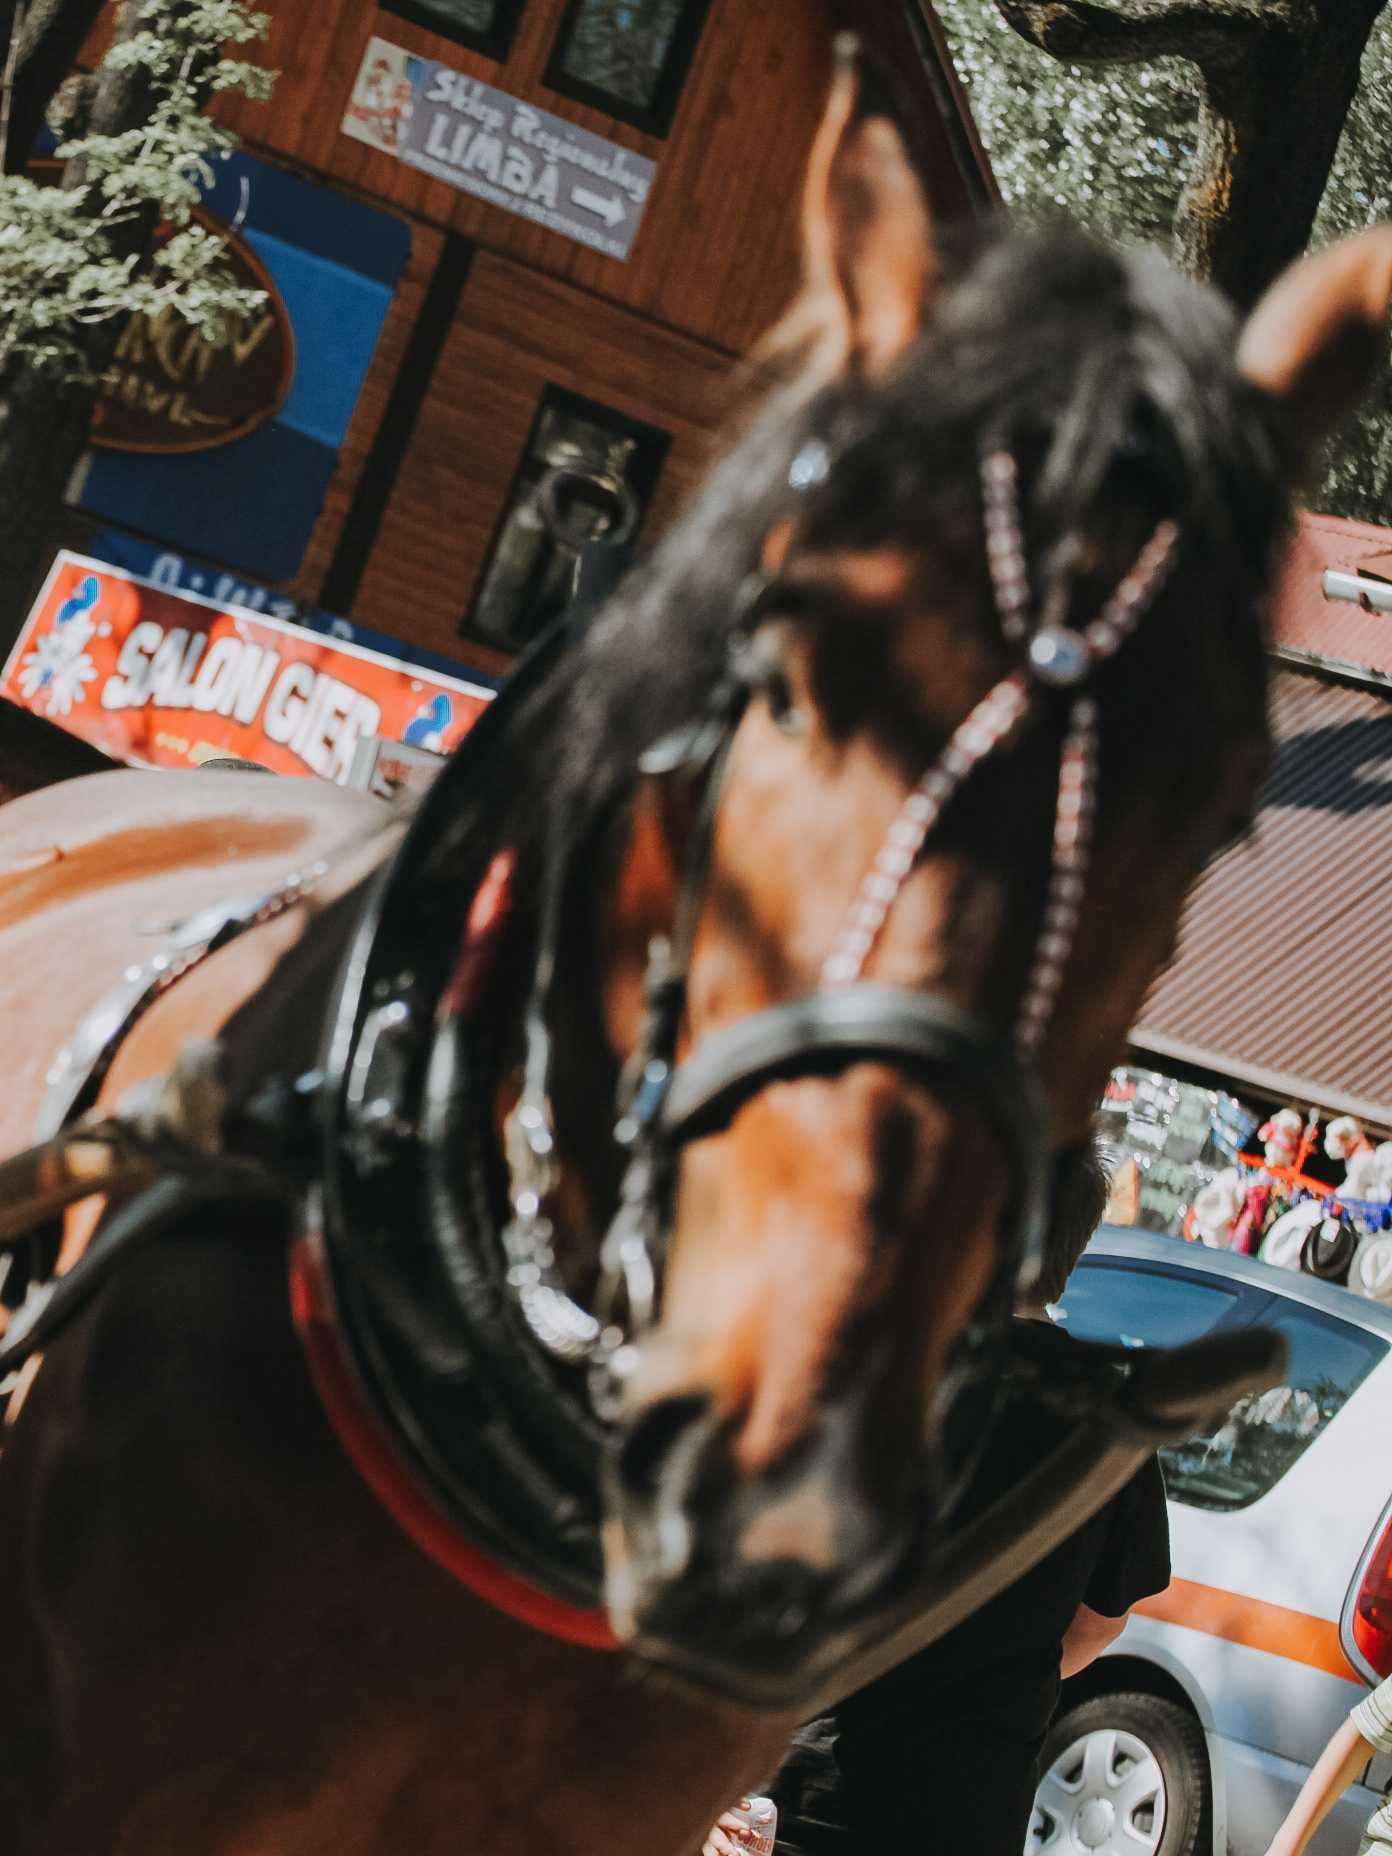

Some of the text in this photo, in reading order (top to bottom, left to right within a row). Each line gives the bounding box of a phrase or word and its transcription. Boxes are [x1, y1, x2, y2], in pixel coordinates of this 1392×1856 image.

[424, 69, 504, 134] Sklep
[425, 113, 559, 209] LIMBA
[100, 620, 381, 788] SALON GIER
